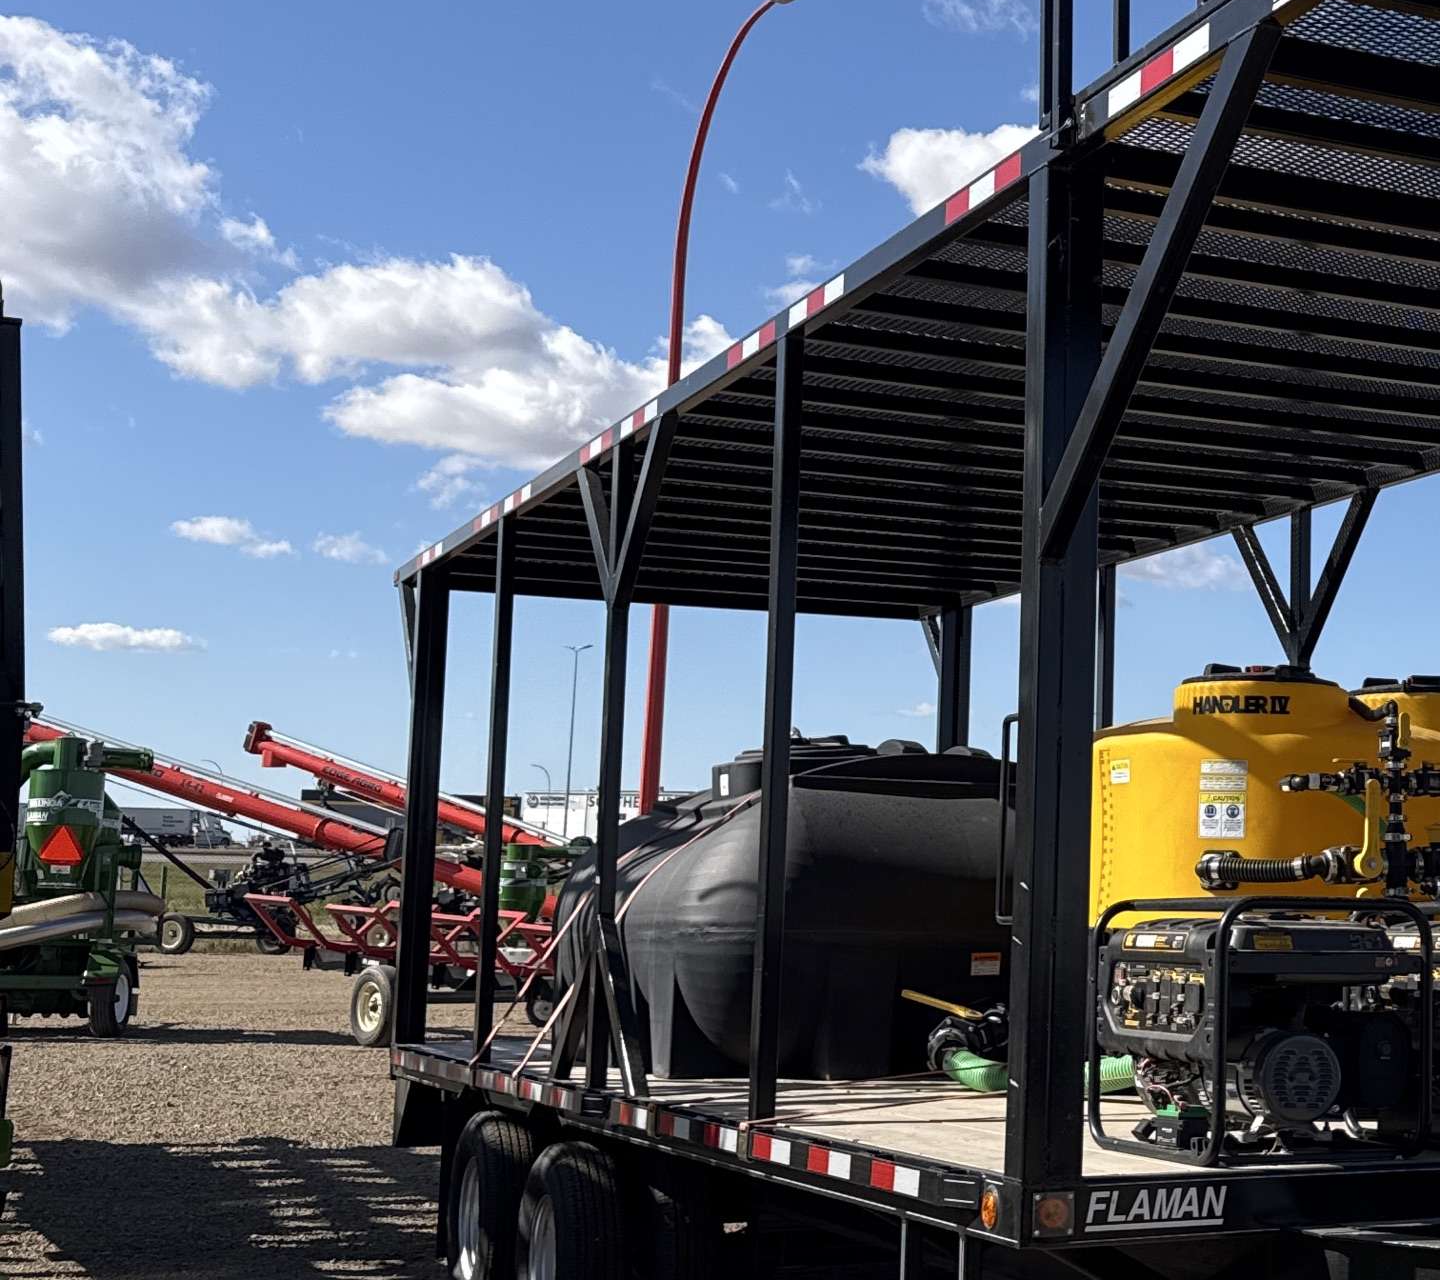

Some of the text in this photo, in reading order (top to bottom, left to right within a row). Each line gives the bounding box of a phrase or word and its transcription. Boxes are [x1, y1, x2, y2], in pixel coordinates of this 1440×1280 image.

[1193, 695, 1290, 715] HANDLER IV
[1085, 1185, 1228, 1224] FLAMAN
